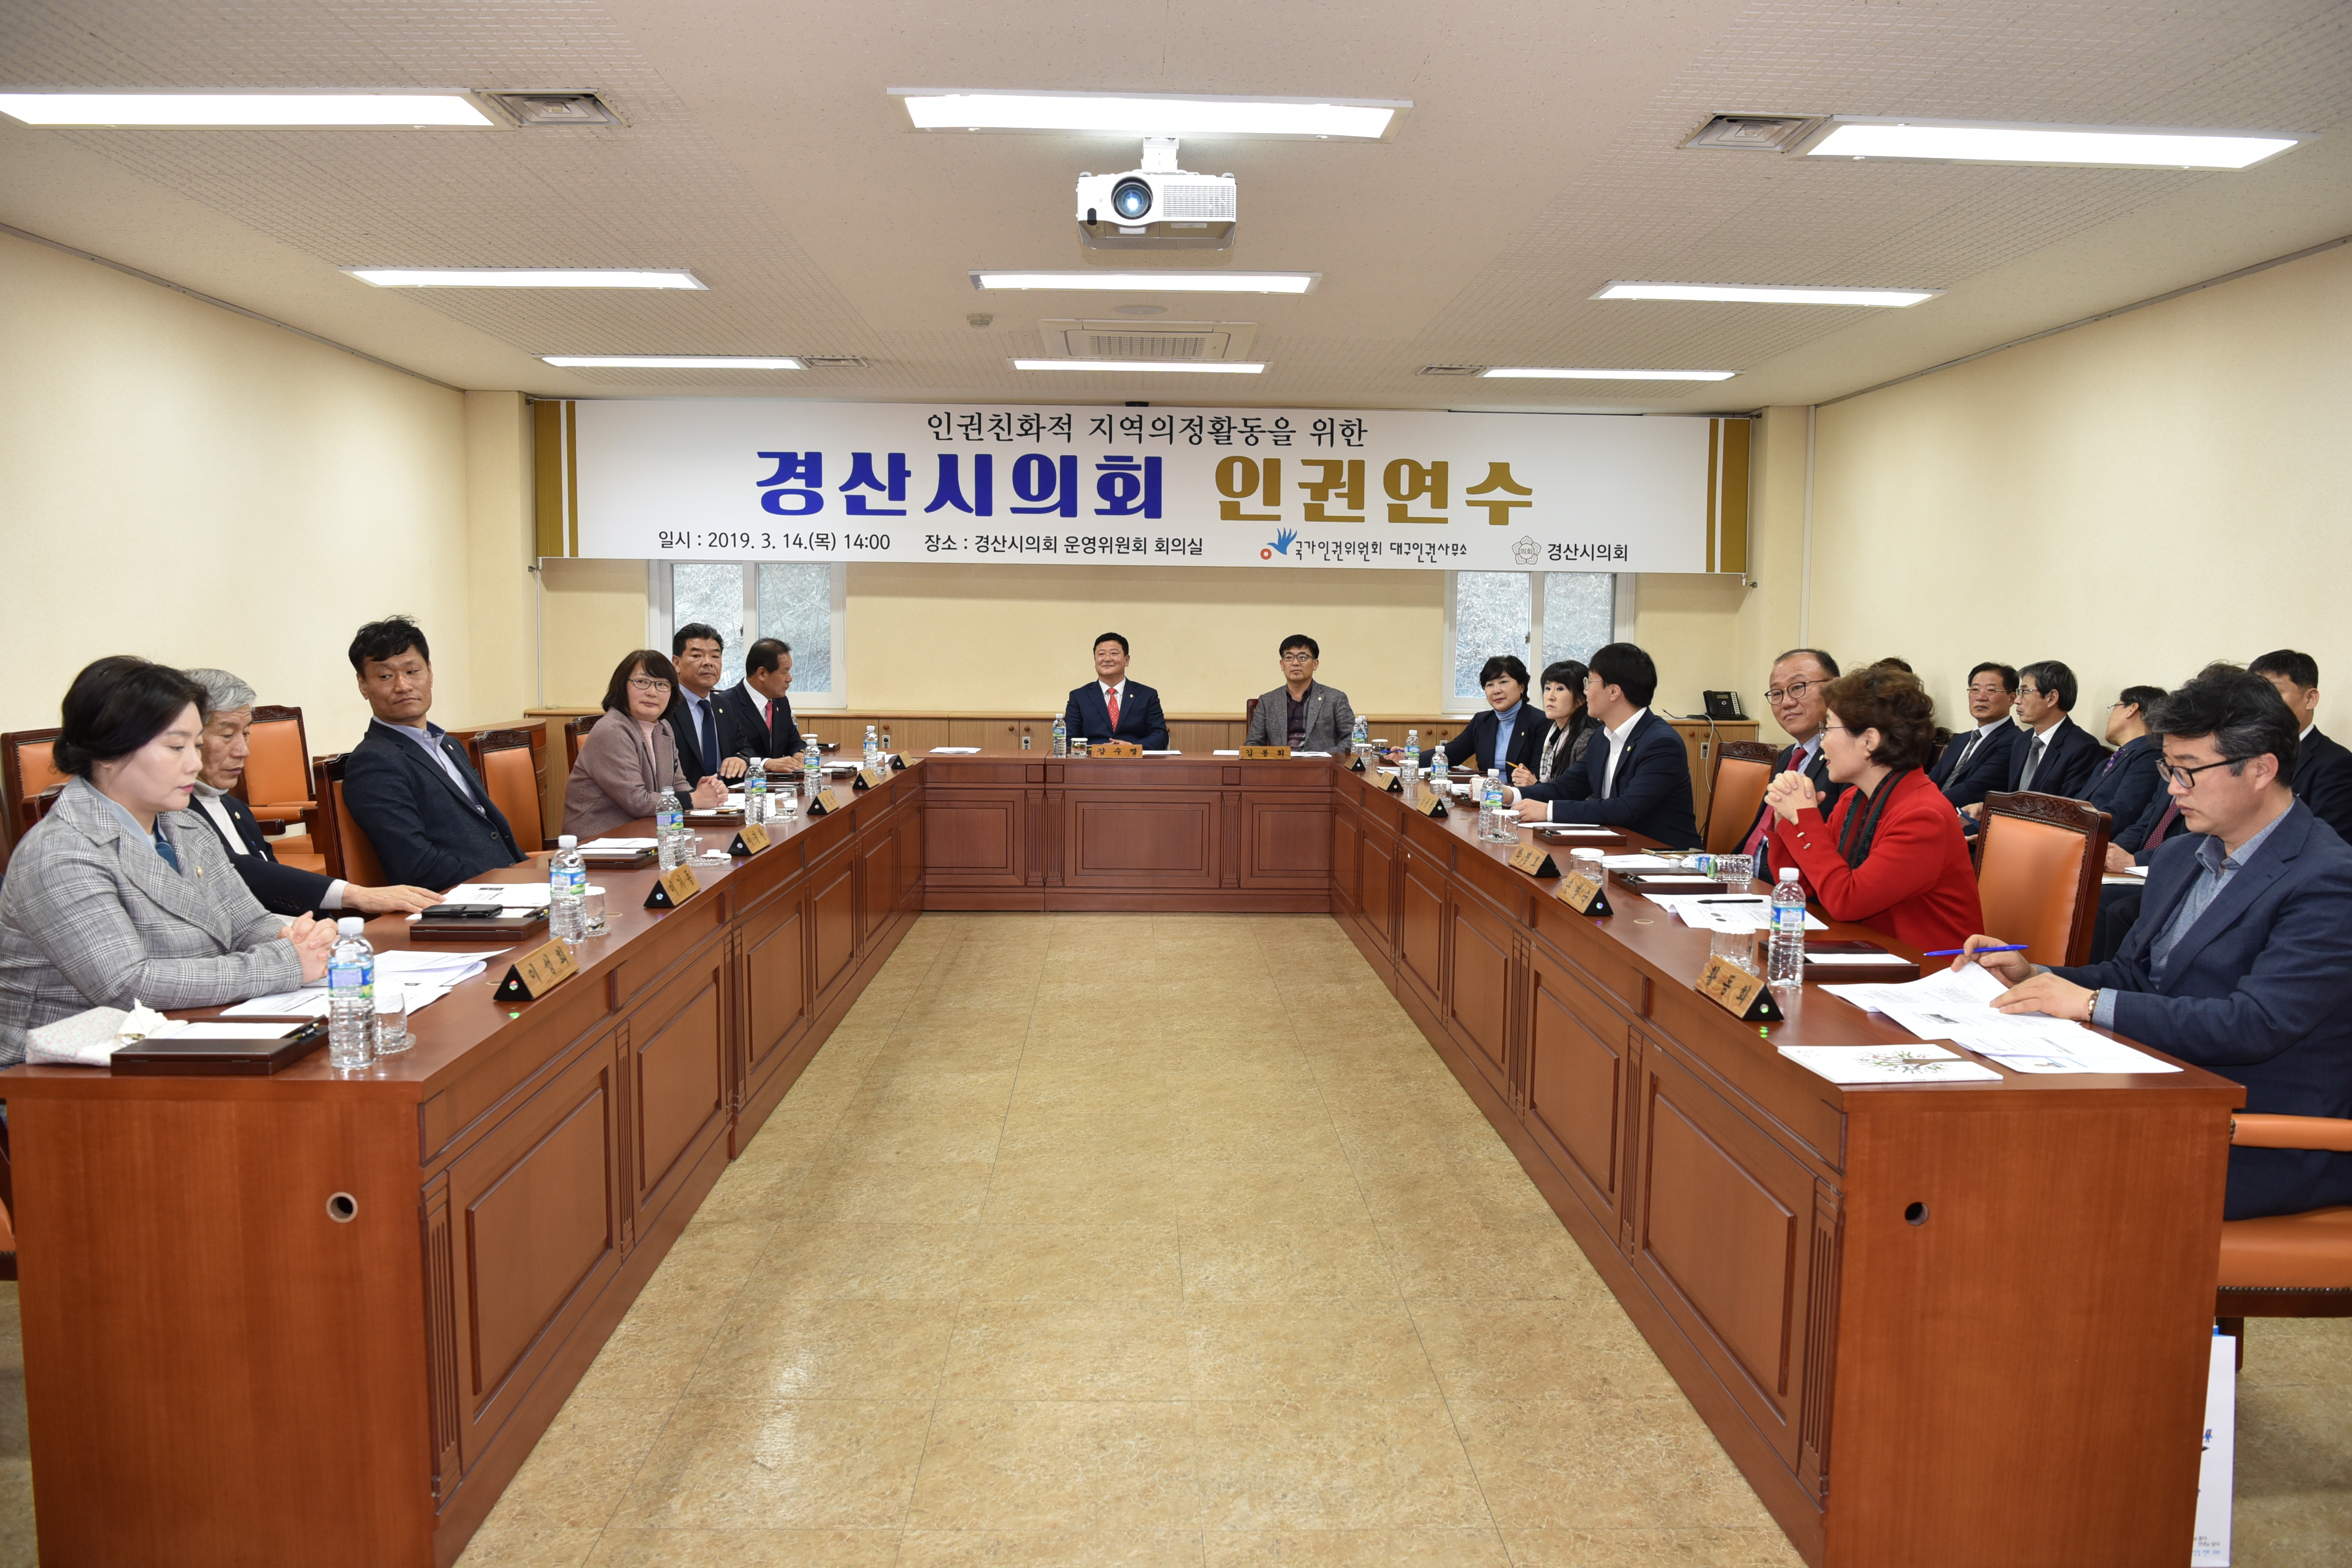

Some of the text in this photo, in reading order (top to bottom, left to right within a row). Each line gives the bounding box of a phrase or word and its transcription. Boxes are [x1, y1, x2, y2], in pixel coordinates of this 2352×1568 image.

[927, 411, 1369, 448] 인권친화적 지역의정활동을 위한
[755, 451, 1534, 526] 경산시의회 인권연수
[657, 531, 690, 549] 일시
[708, 532, 754, 549] 2019.
[761, 533, 776, 549] 3.
[783, 532, 836, 551] 14.(목)
[844, 534, 890, 550] 14:00
[924, 534, 958, 553] 장소
[975, 535, 1057, 554] 경산시의회
[1063, 536, 1147, 555] 운영위원회
[1154, 537, 1203, 556] 회의실
[1295, 540, 1467, 563] 국가인권위원회 대구인권사무소
[1547, 543, 1627, 562] 경산시의회
